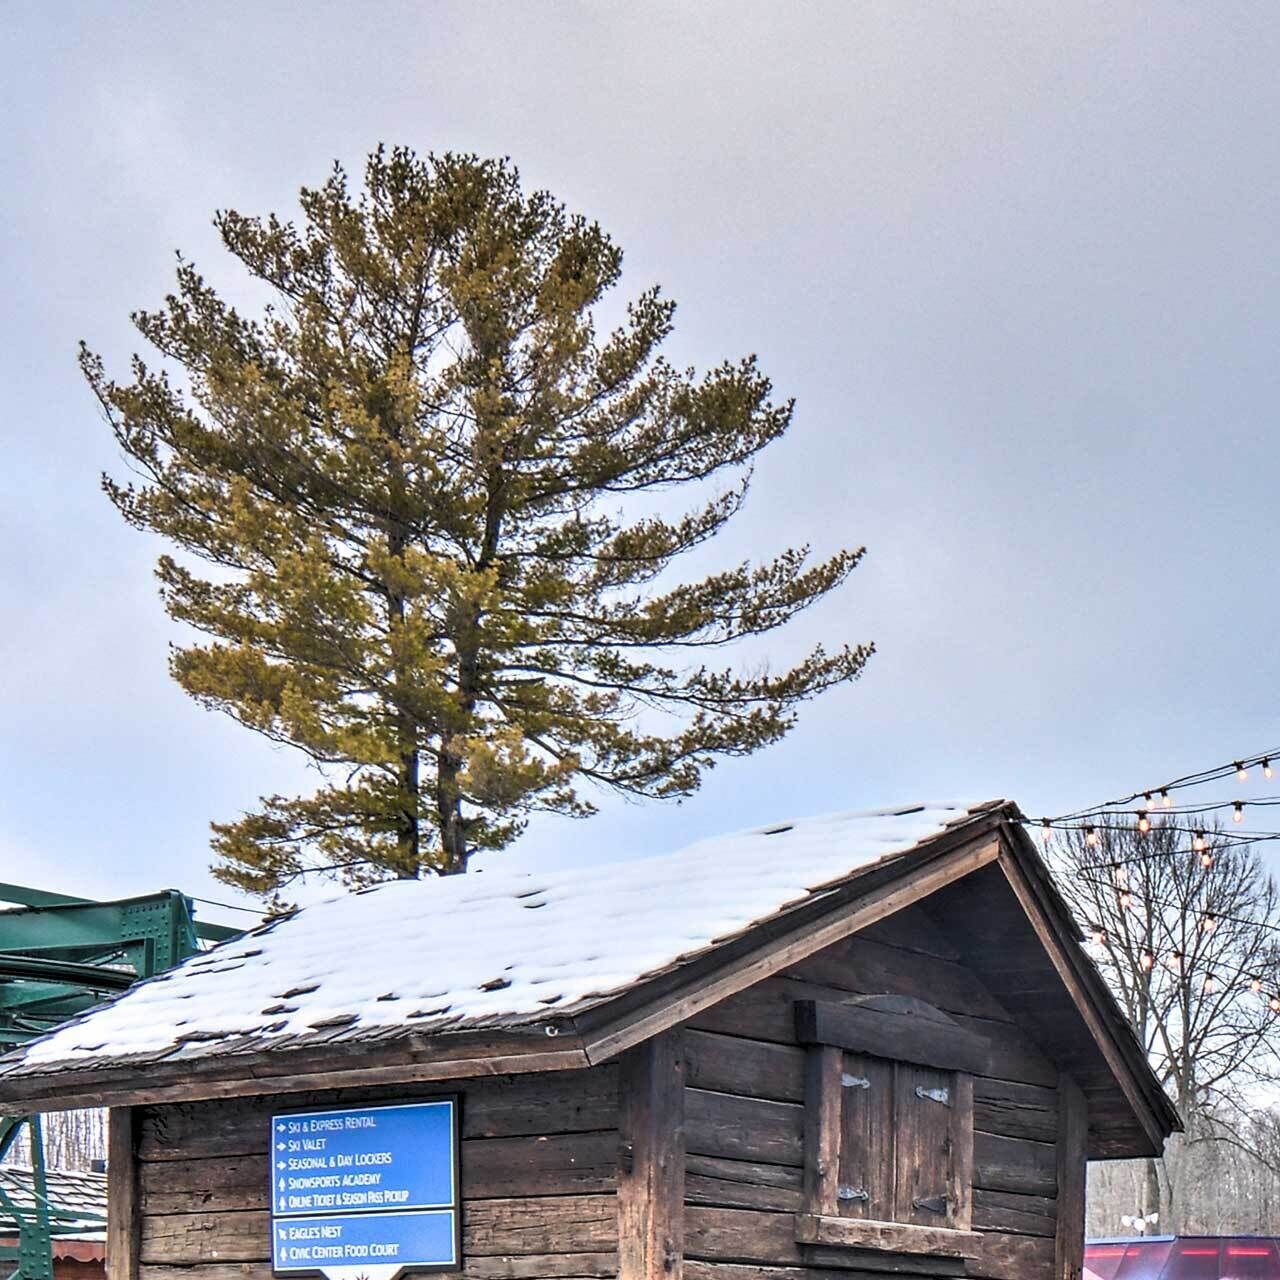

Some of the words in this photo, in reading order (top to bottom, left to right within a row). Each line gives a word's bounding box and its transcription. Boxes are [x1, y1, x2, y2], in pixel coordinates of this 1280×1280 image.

[288, 1122, 301, 1134] SKI
[302, 1122, 308, 1132] &
[311, 1118, 343, 1131] EXPRESS
[345, 1116, 376, 1128] RENTAL
[288, 1139, 301, 1152] SKI
[302, 1138, 326, 1150] VALET
[288, 1157, 327, 1170] SEASONAL
[329, 1157, 335, 1167] &
[338, 1154, 354, 1166] DAY
[356, 1152, 392, 1165] LOCKERS
[288, 1176, 340, 1189] SNOWSPORTS
[342, 1173, 382, 1186] ACADEMY
[313, 1194, 335, 1206] TICKET
[336, 1194, 342, 1206] &
[342, 1192, 367, 1205] SEASON
[367, 1191, 384, 1203] PASS
[321, 1226, 342, 1238] NEST
[290, 1247, 311, 1260] CIVIC
[312, 1246, 343, 1258] CENTER
[344, 1245, 368, 1257] FOOD
[369, 1244, 400, 1256] COURT
